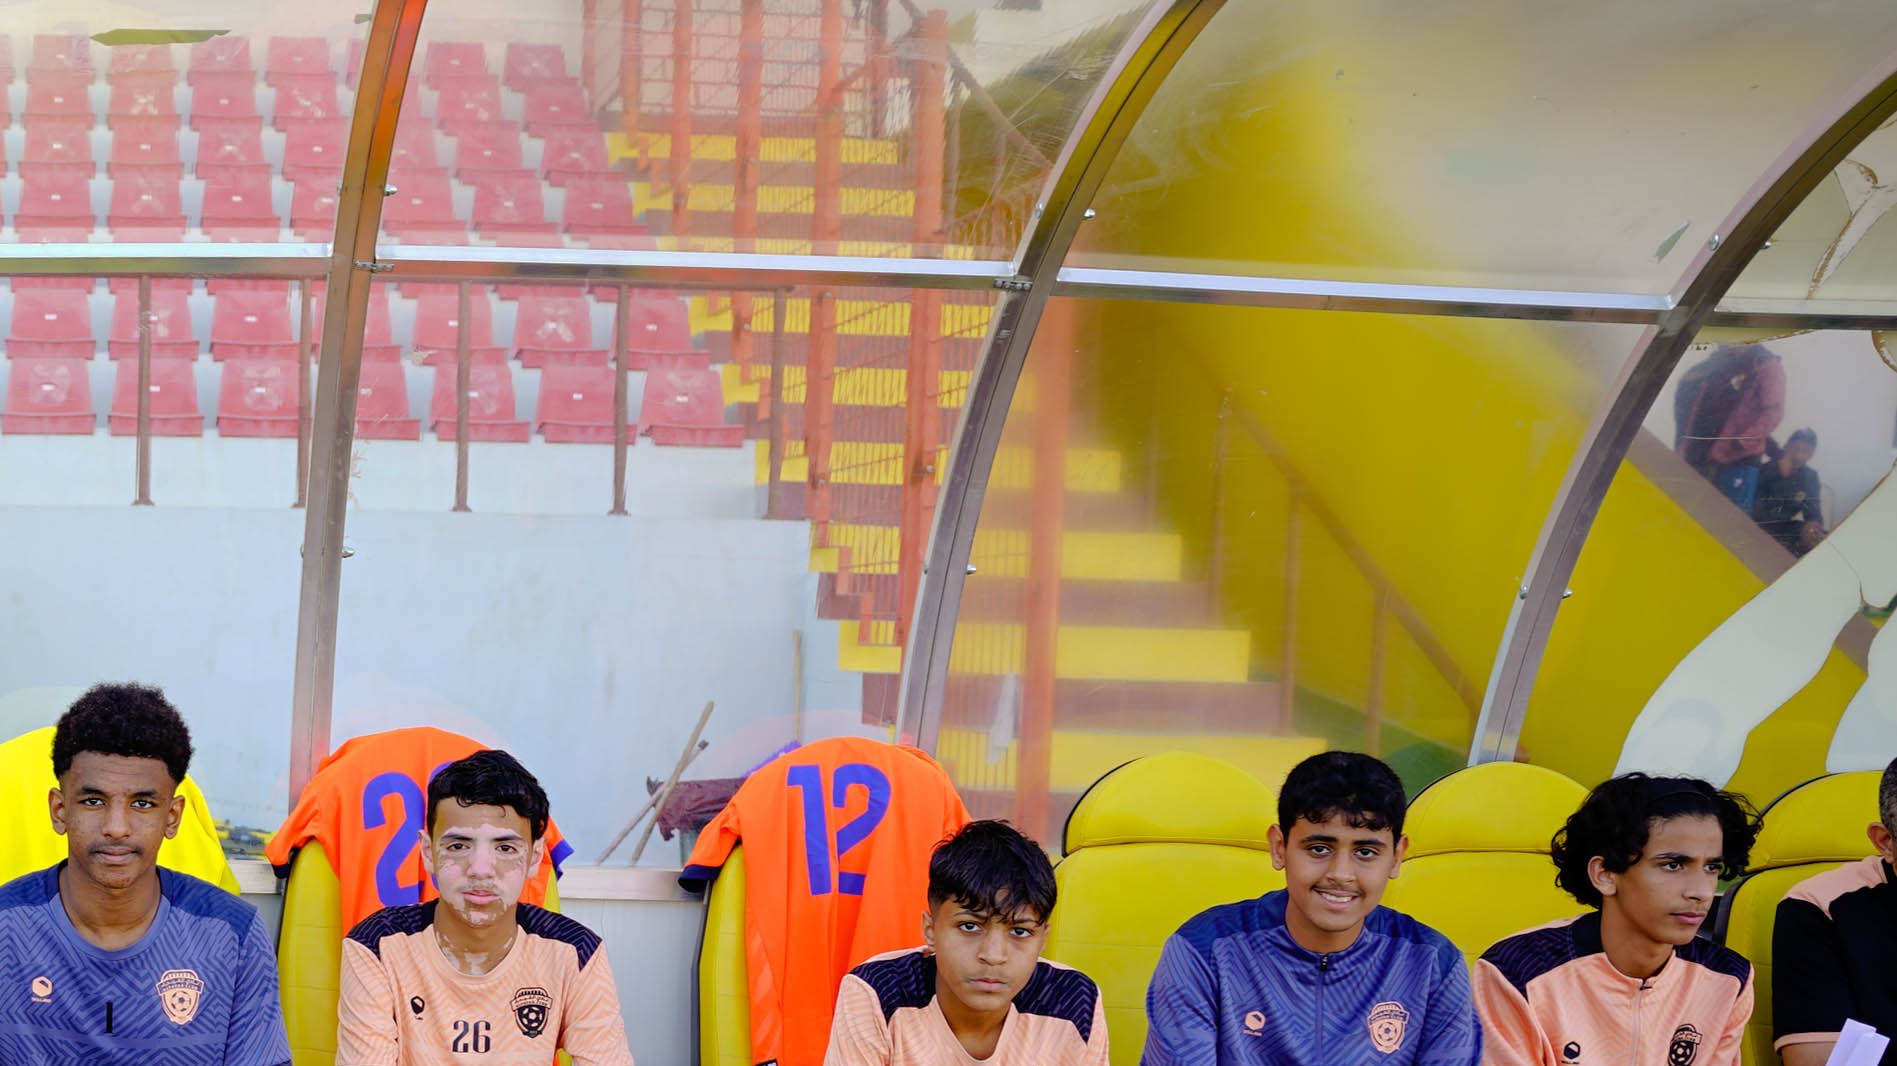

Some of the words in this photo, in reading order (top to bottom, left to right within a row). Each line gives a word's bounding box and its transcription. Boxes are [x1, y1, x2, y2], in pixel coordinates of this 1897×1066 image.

[362, 760, 454, 906] 2
[787, 762, 892, 897] 12
[104, 1001, 115, 1034] 1
[451, 1019, 491, 1053] 26
